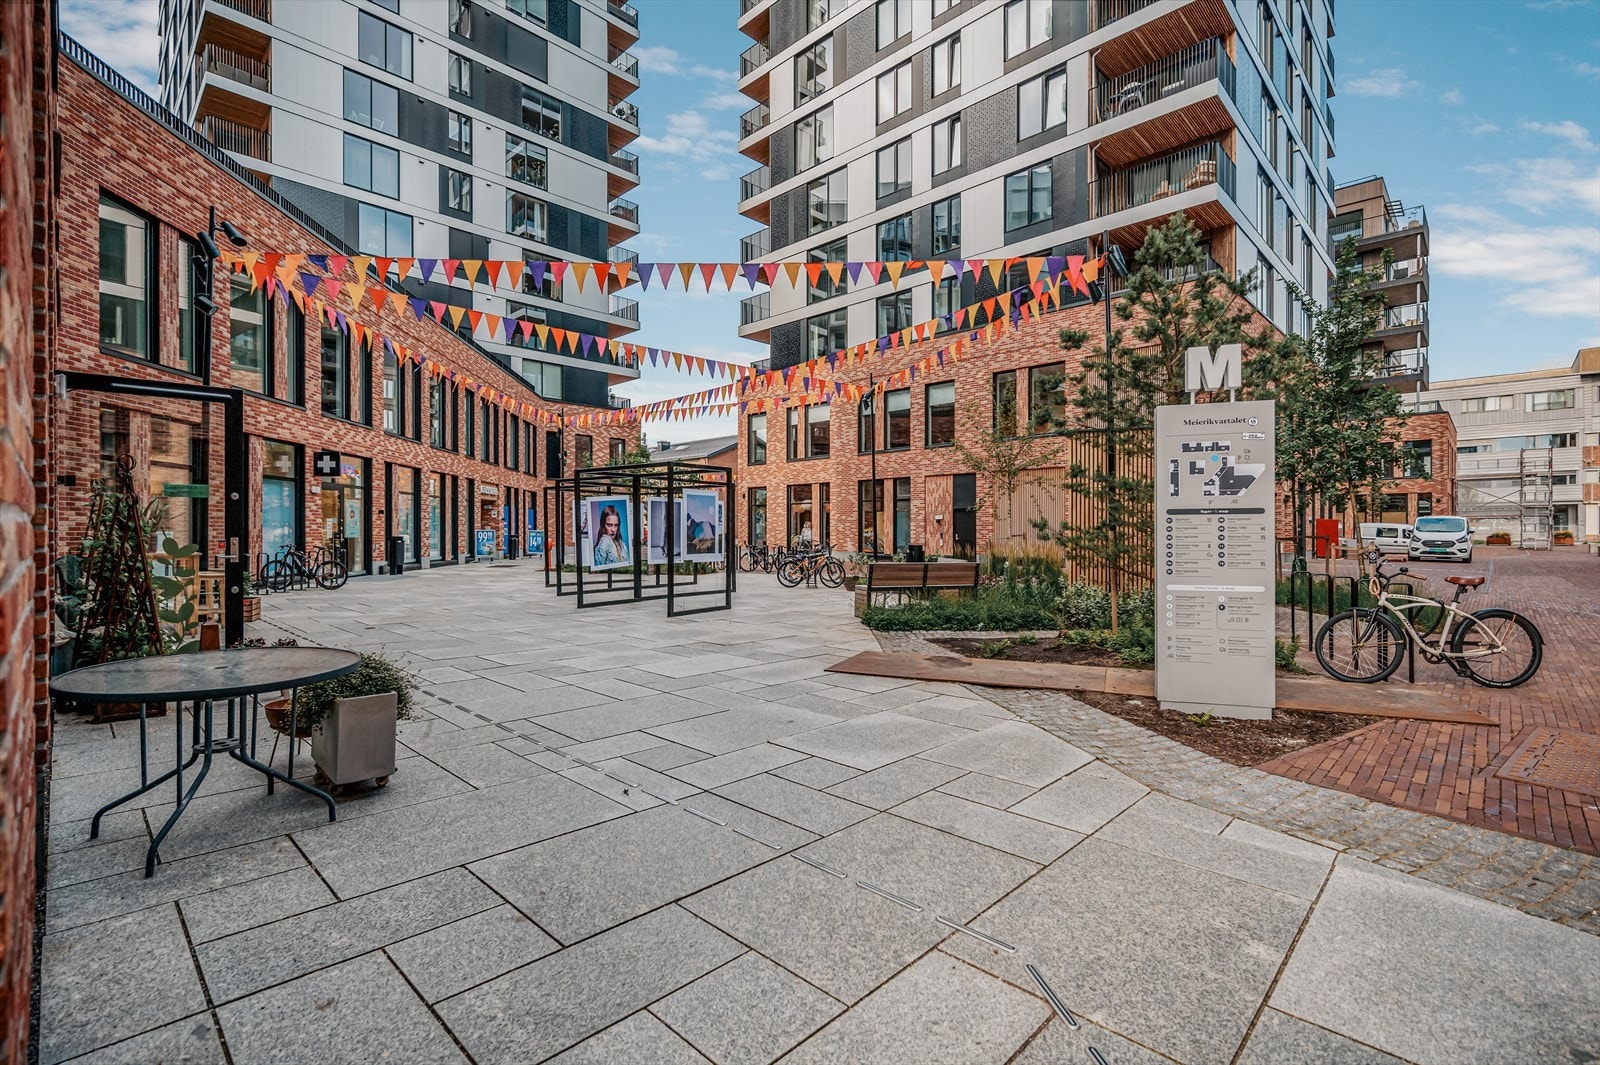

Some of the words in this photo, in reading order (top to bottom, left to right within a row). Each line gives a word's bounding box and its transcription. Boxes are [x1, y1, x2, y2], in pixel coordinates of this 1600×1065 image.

[1185, 343, 1242, 393] M
[1183, 417, 1246, 426] Meierikvartalet
[477, 531, 488, 543] 99
[529, 536, 537, 547] 14
